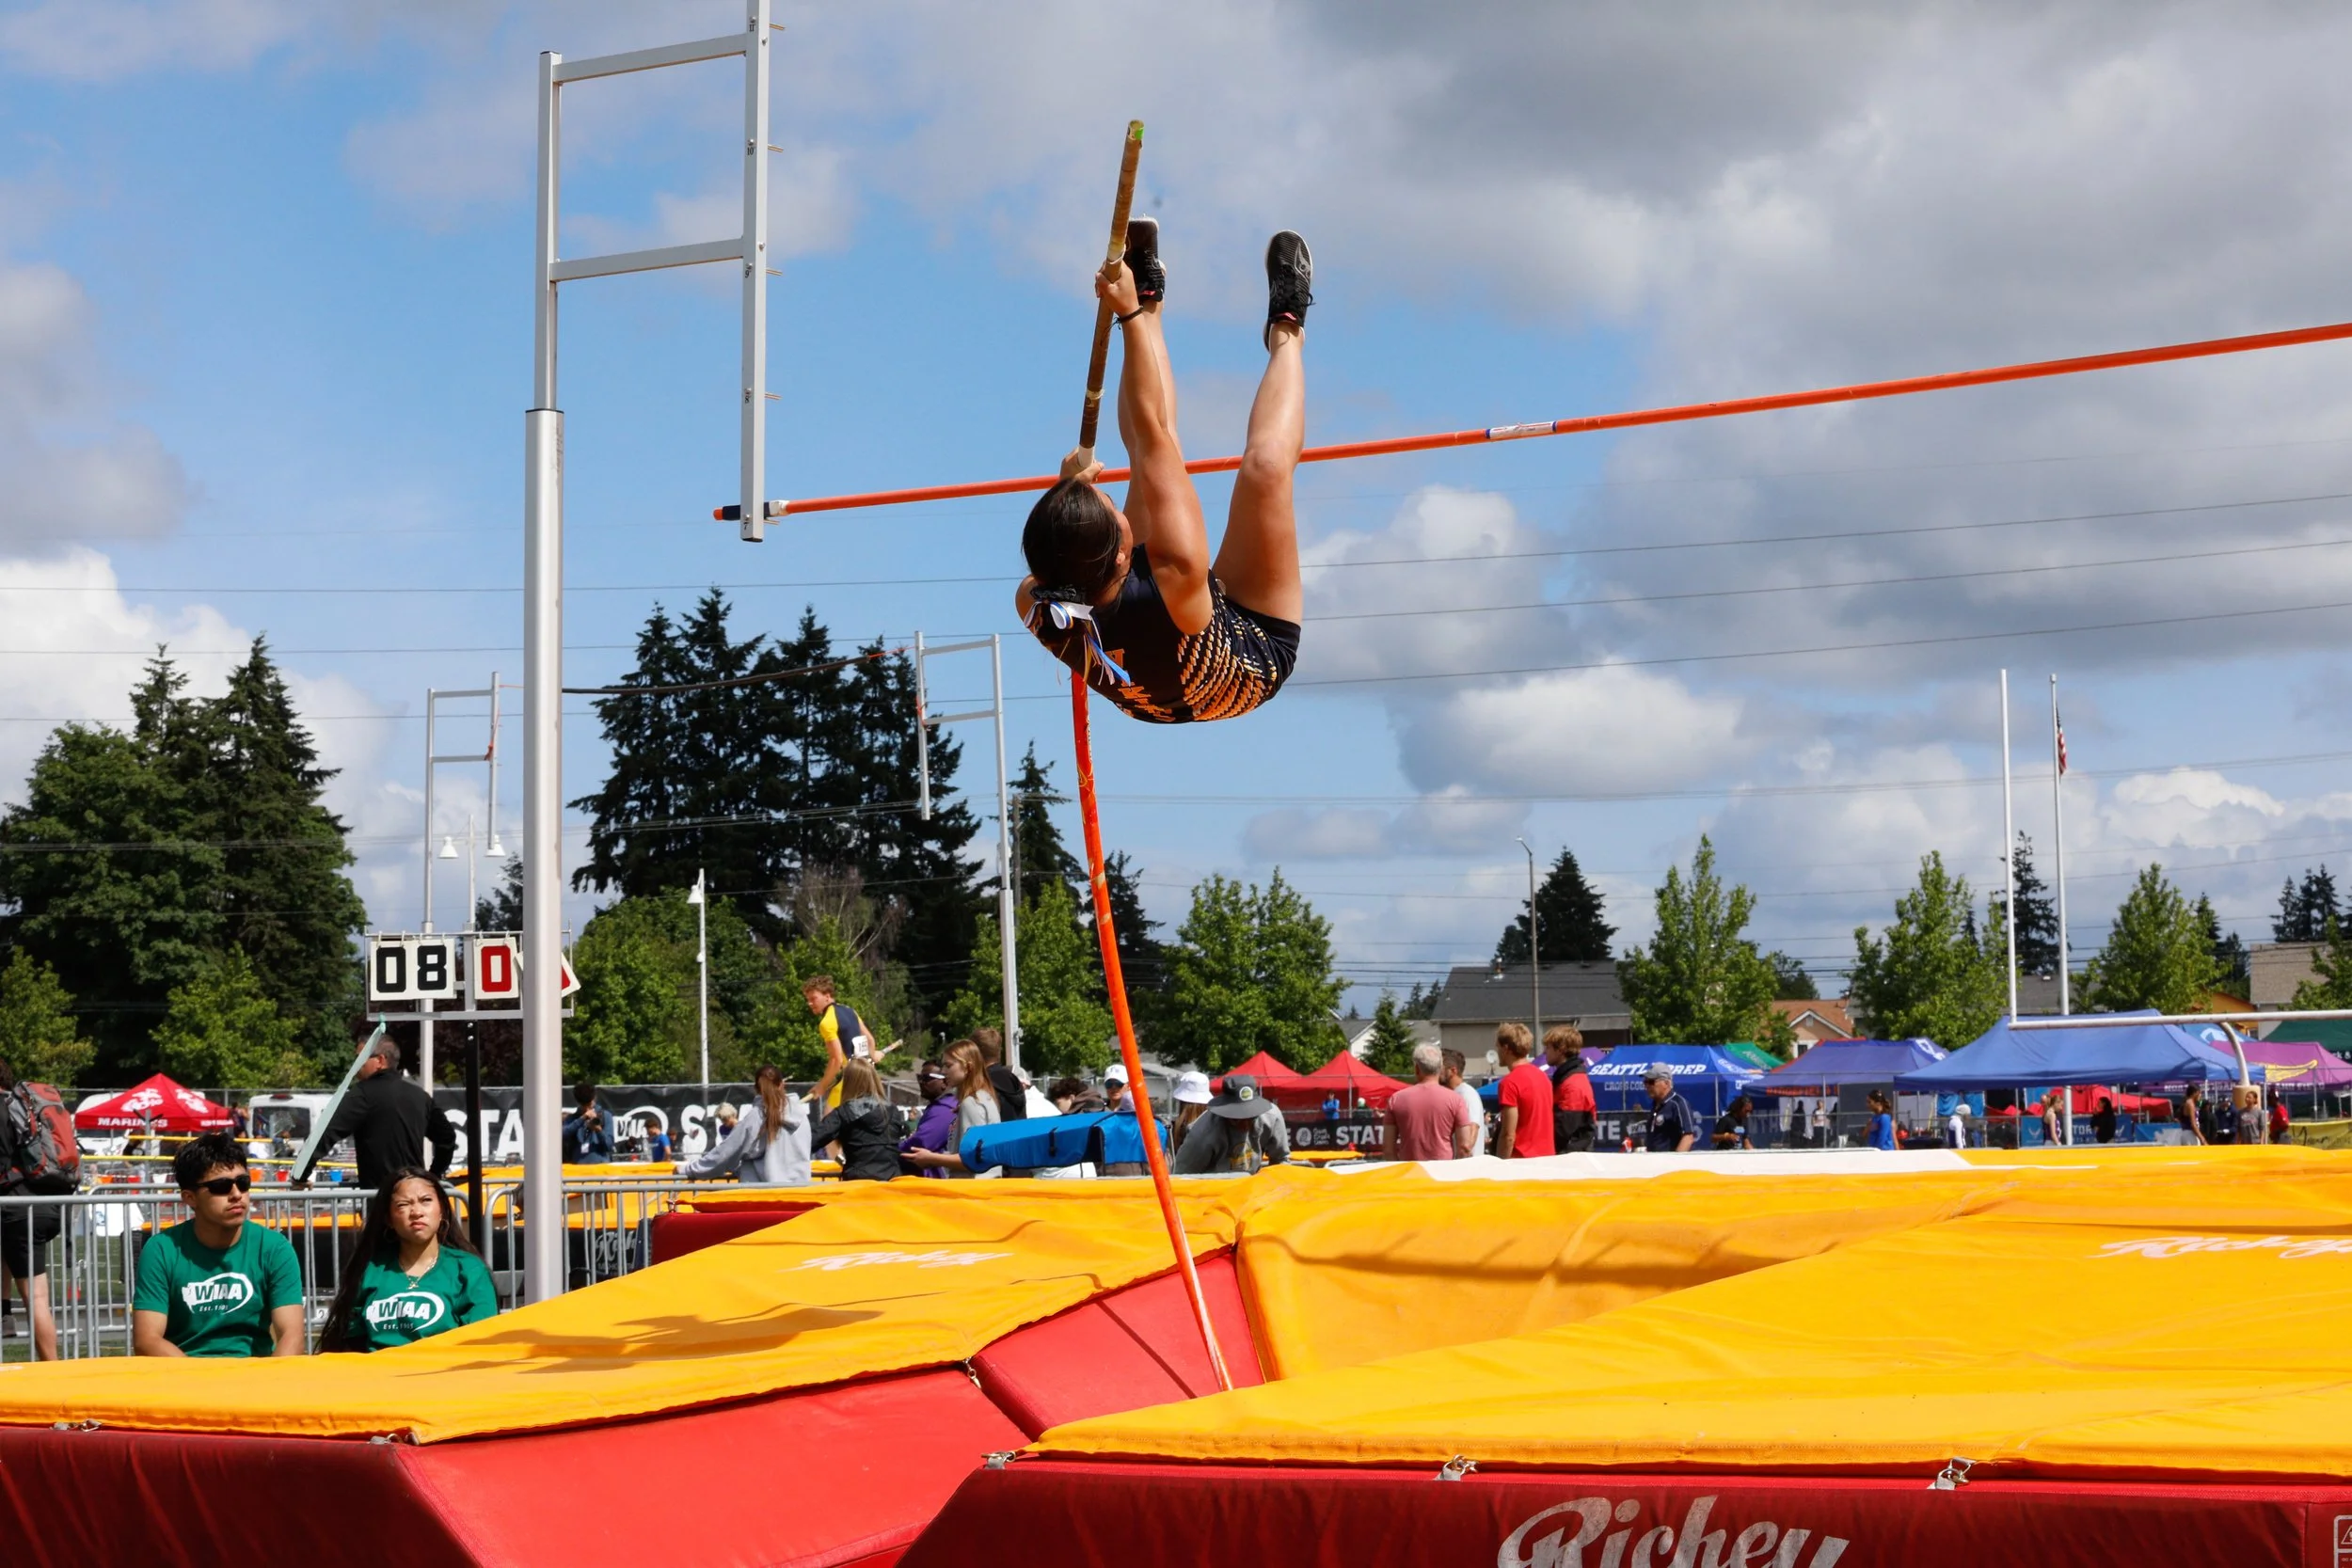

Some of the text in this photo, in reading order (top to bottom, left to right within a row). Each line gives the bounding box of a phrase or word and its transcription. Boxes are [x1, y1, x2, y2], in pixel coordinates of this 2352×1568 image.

[376, 945, 448, 993] 08
[1589, 1062, 1657, 1075] SEATTL
[1669, 1064, 1707, 1075] REP
